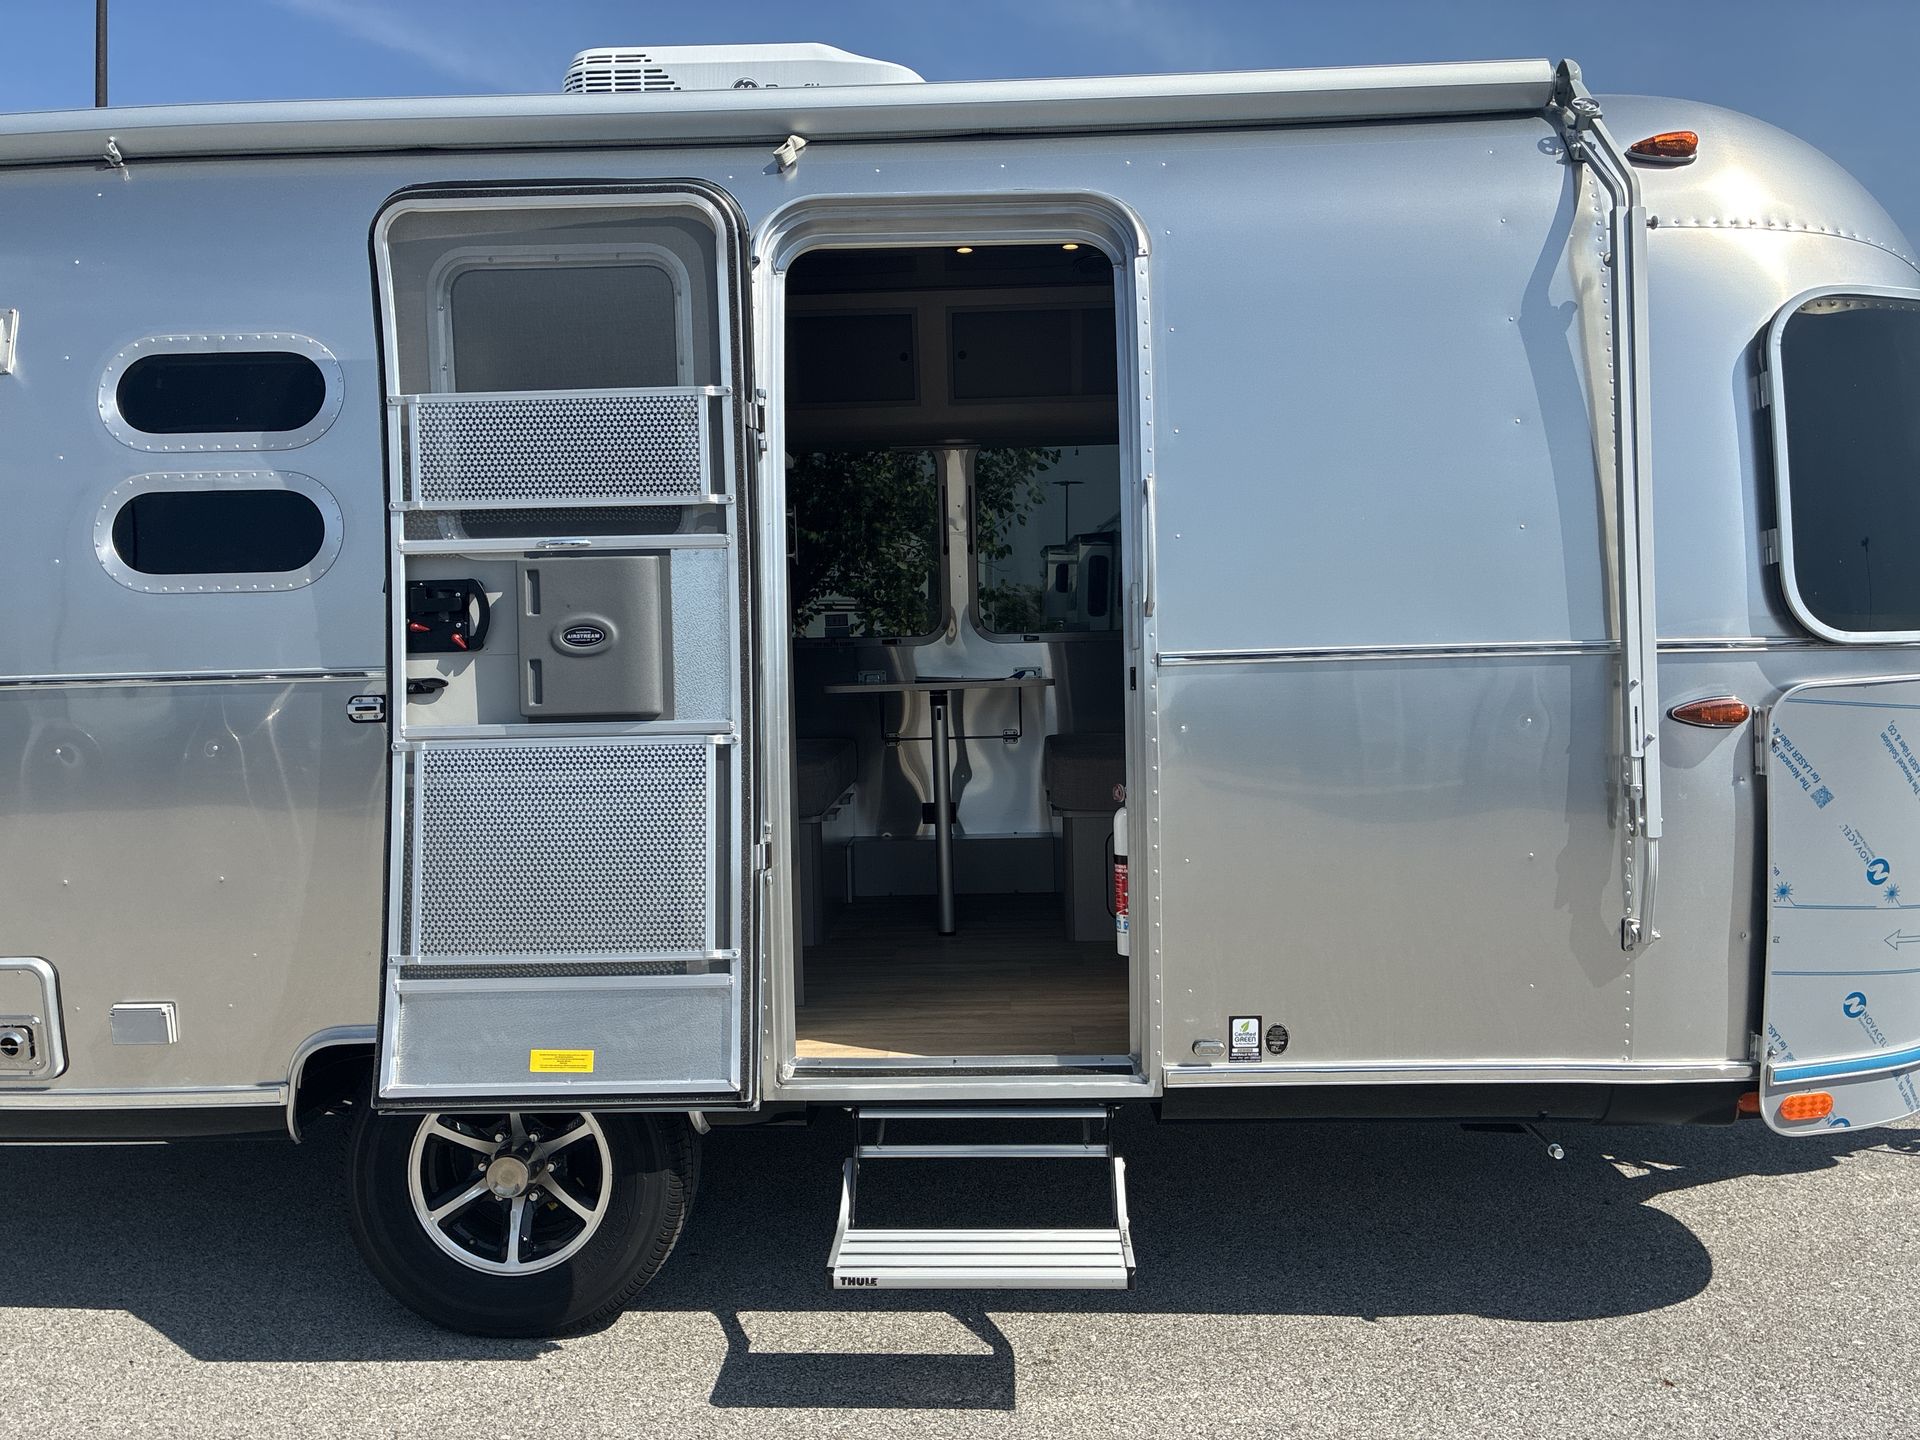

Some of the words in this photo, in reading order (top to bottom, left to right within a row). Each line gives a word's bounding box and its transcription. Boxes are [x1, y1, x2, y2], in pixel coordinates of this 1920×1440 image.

[1779, 733, 1795, 752] Fiber
[1880, 731, 1900, 760] Solution
[1899, 740, 1912, 758] Fiber
[1776, 751, 1802, 779] Novacel
[1791, 750, 1813, 774] LASER
[1895, 757, 1914, 783] Novacel
[1799, 776, 1811, 791] The
[1810, 771, 1822, 784] for
[1841, 824, 1872, 865] NOVACEL
[1862, 1011, 1888, 1048] NOVACEL
[1778, 1040, 1788, 1051] for
[840, 1277, 878, 1286] THULE
